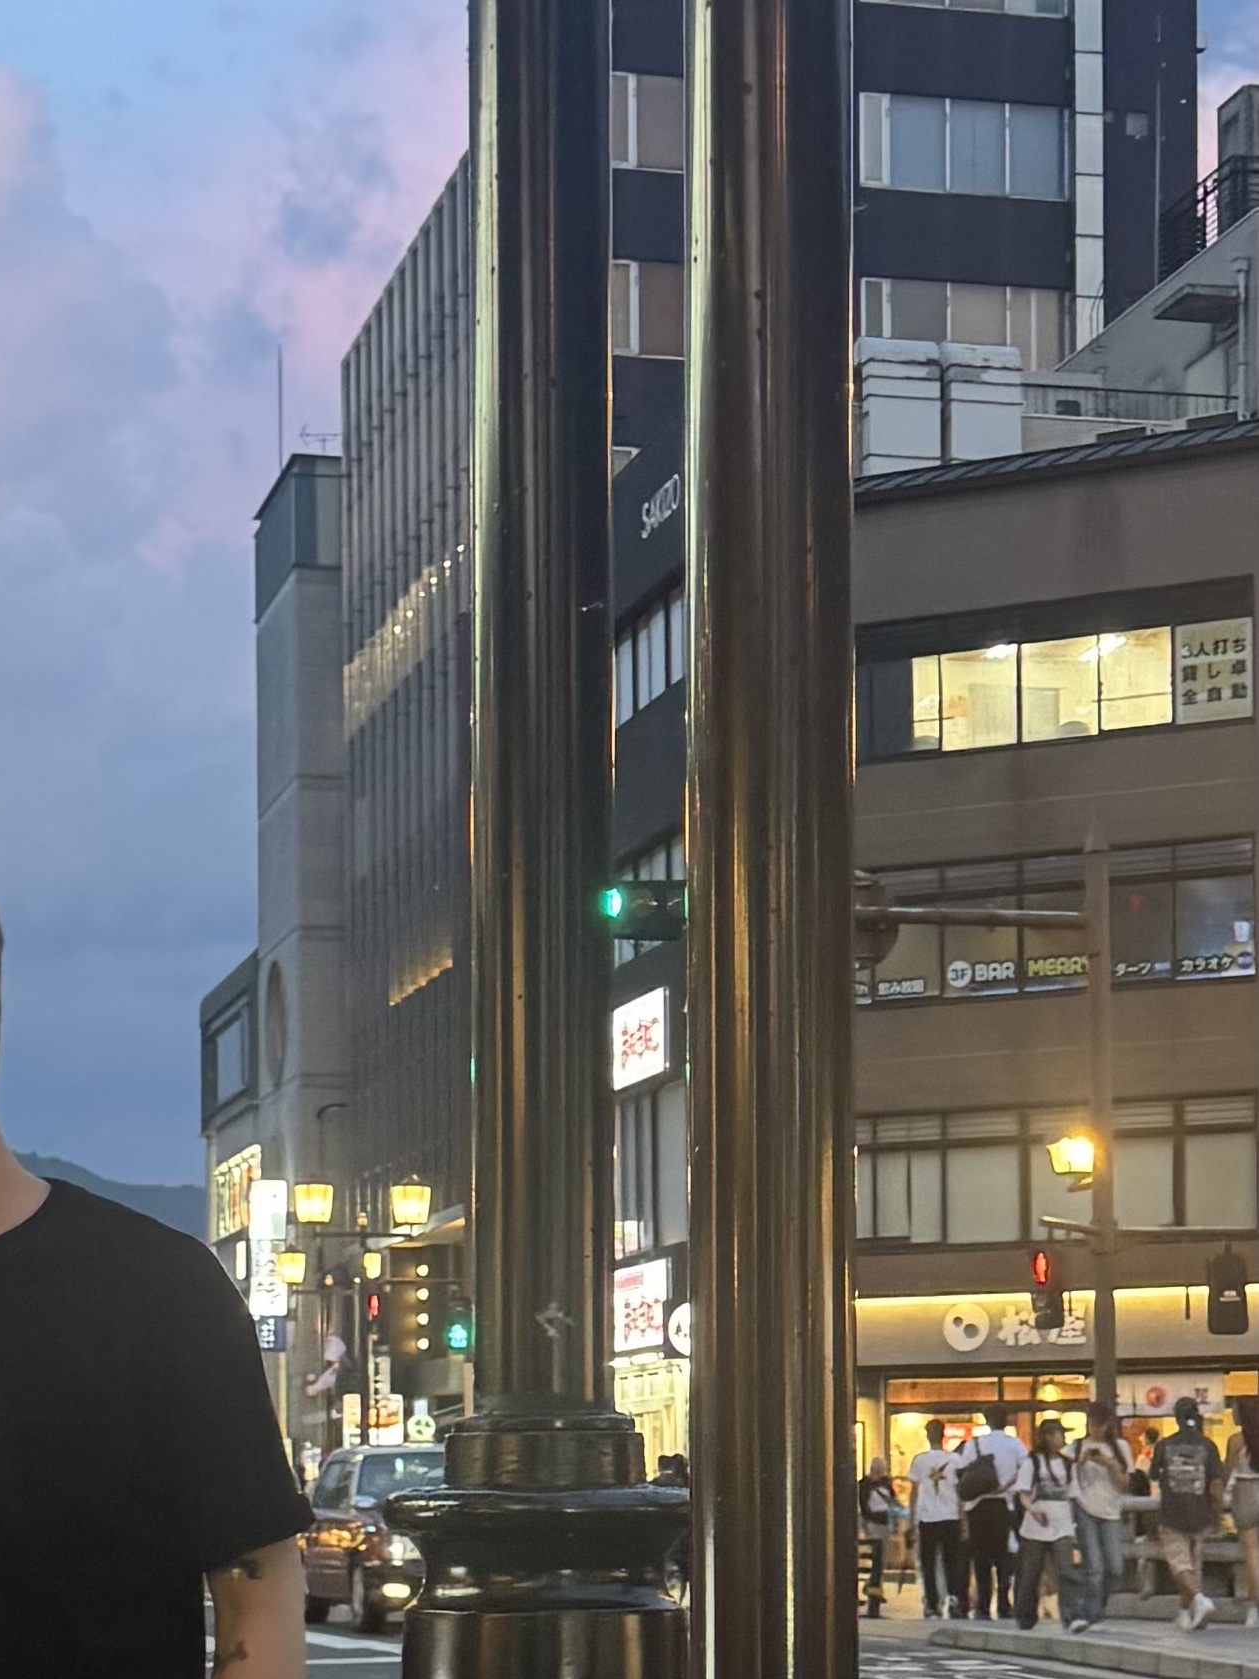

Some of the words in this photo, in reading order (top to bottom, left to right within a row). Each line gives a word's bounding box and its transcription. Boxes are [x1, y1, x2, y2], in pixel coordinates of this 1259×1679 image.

[1182, 638, 1247, 659] 3人打ち
[975, 961, 1015, 982] BAR
[1181, 956, 1234, 973] カラオケ
